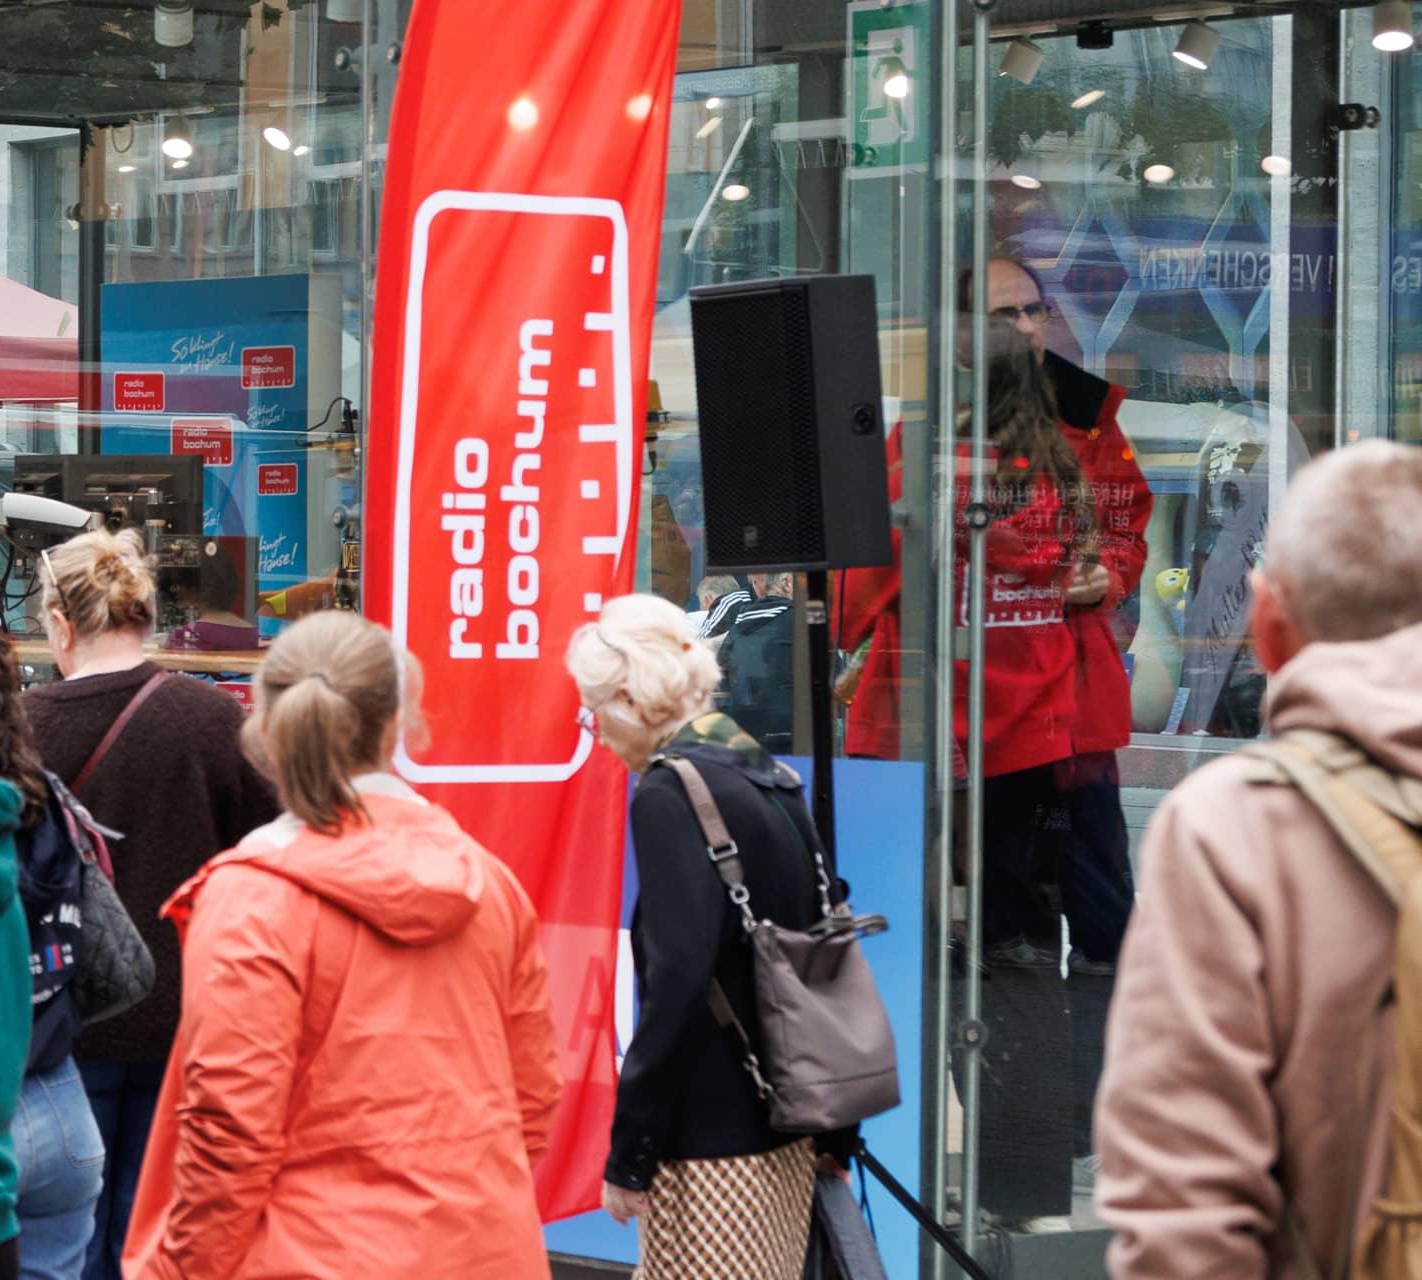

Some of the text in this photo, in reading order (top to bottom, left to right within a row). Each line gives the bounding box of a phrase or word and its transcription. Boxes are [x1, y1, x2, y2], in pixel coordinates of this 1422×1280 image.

[251, 355, 274, 363] radio
[251, 365, 285, 375] bochum
[123, 379, 145, 388] radio
[123, 389, 155, 398] bochum
[182, 427, 208, 437] radio
[182, 438, 221, 449] bochum
[495, 318, 554, 661] bochum
[440, 436, 489, 660] radio
